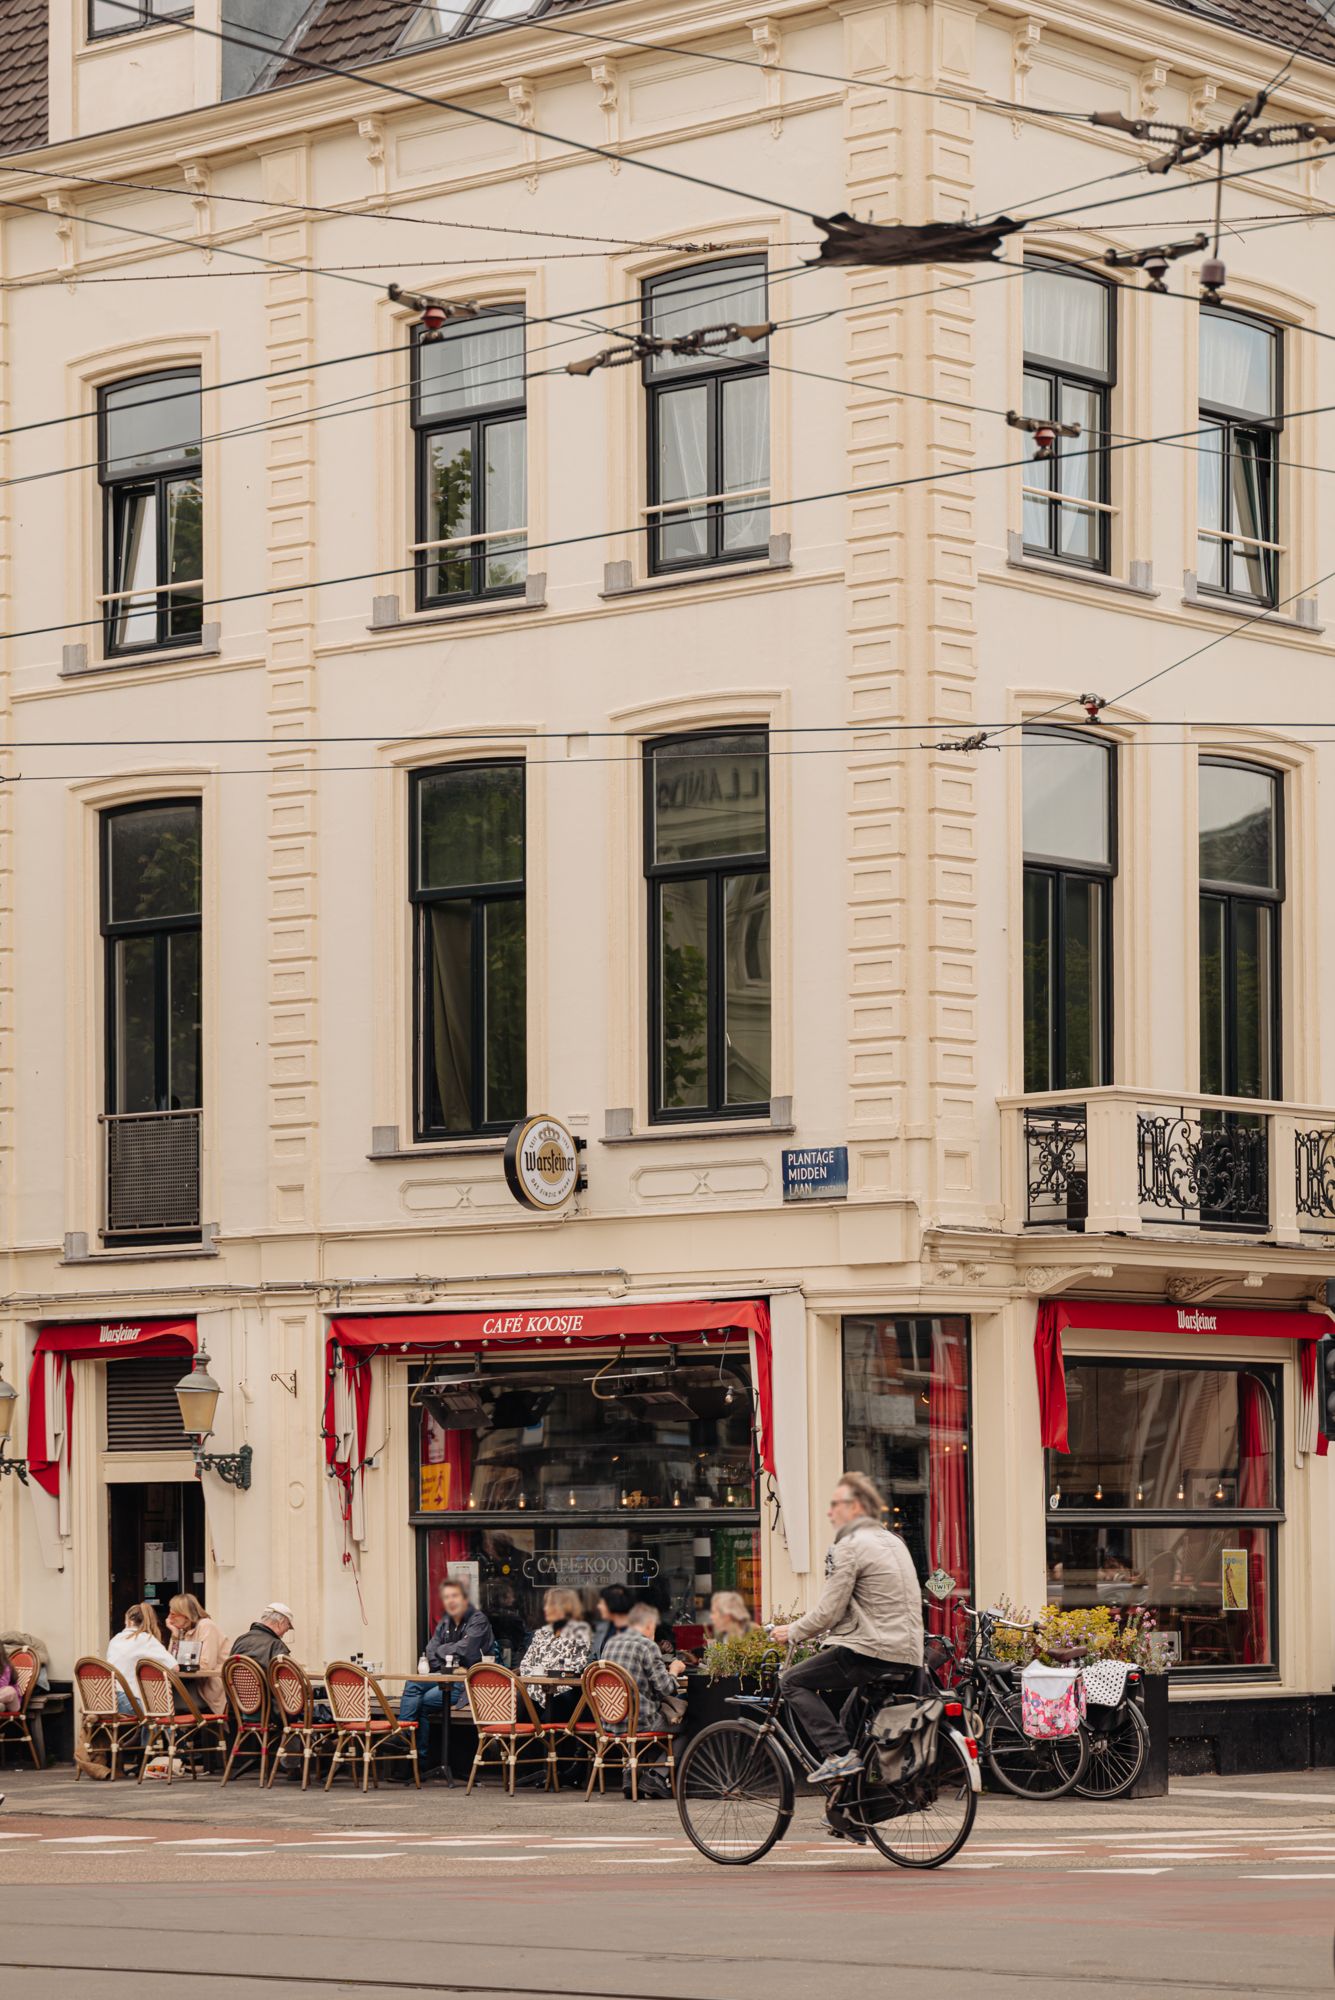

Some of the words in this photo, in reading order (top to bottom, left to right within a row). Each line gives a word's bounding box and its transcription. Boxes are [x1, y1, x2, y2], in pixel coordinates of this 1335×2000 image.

[524, 1149, 574, 1174] Warsteiner
[788, 1150, 834, 1166] PLANTAGE
[788, 1166, 827, 1181] MIDDEN
[789, 1182, 812, 1196] LAAN
[483, 1314, 523, 1334] CAFÉ
[525, 1315, 584, 1335] KOOSJE
[1176, 1309, 1217, 1332] Warsteiner
[99, 1323, 142, 1344] Warsteiner
[584, 1557, 645, 1574] KOOSJE
